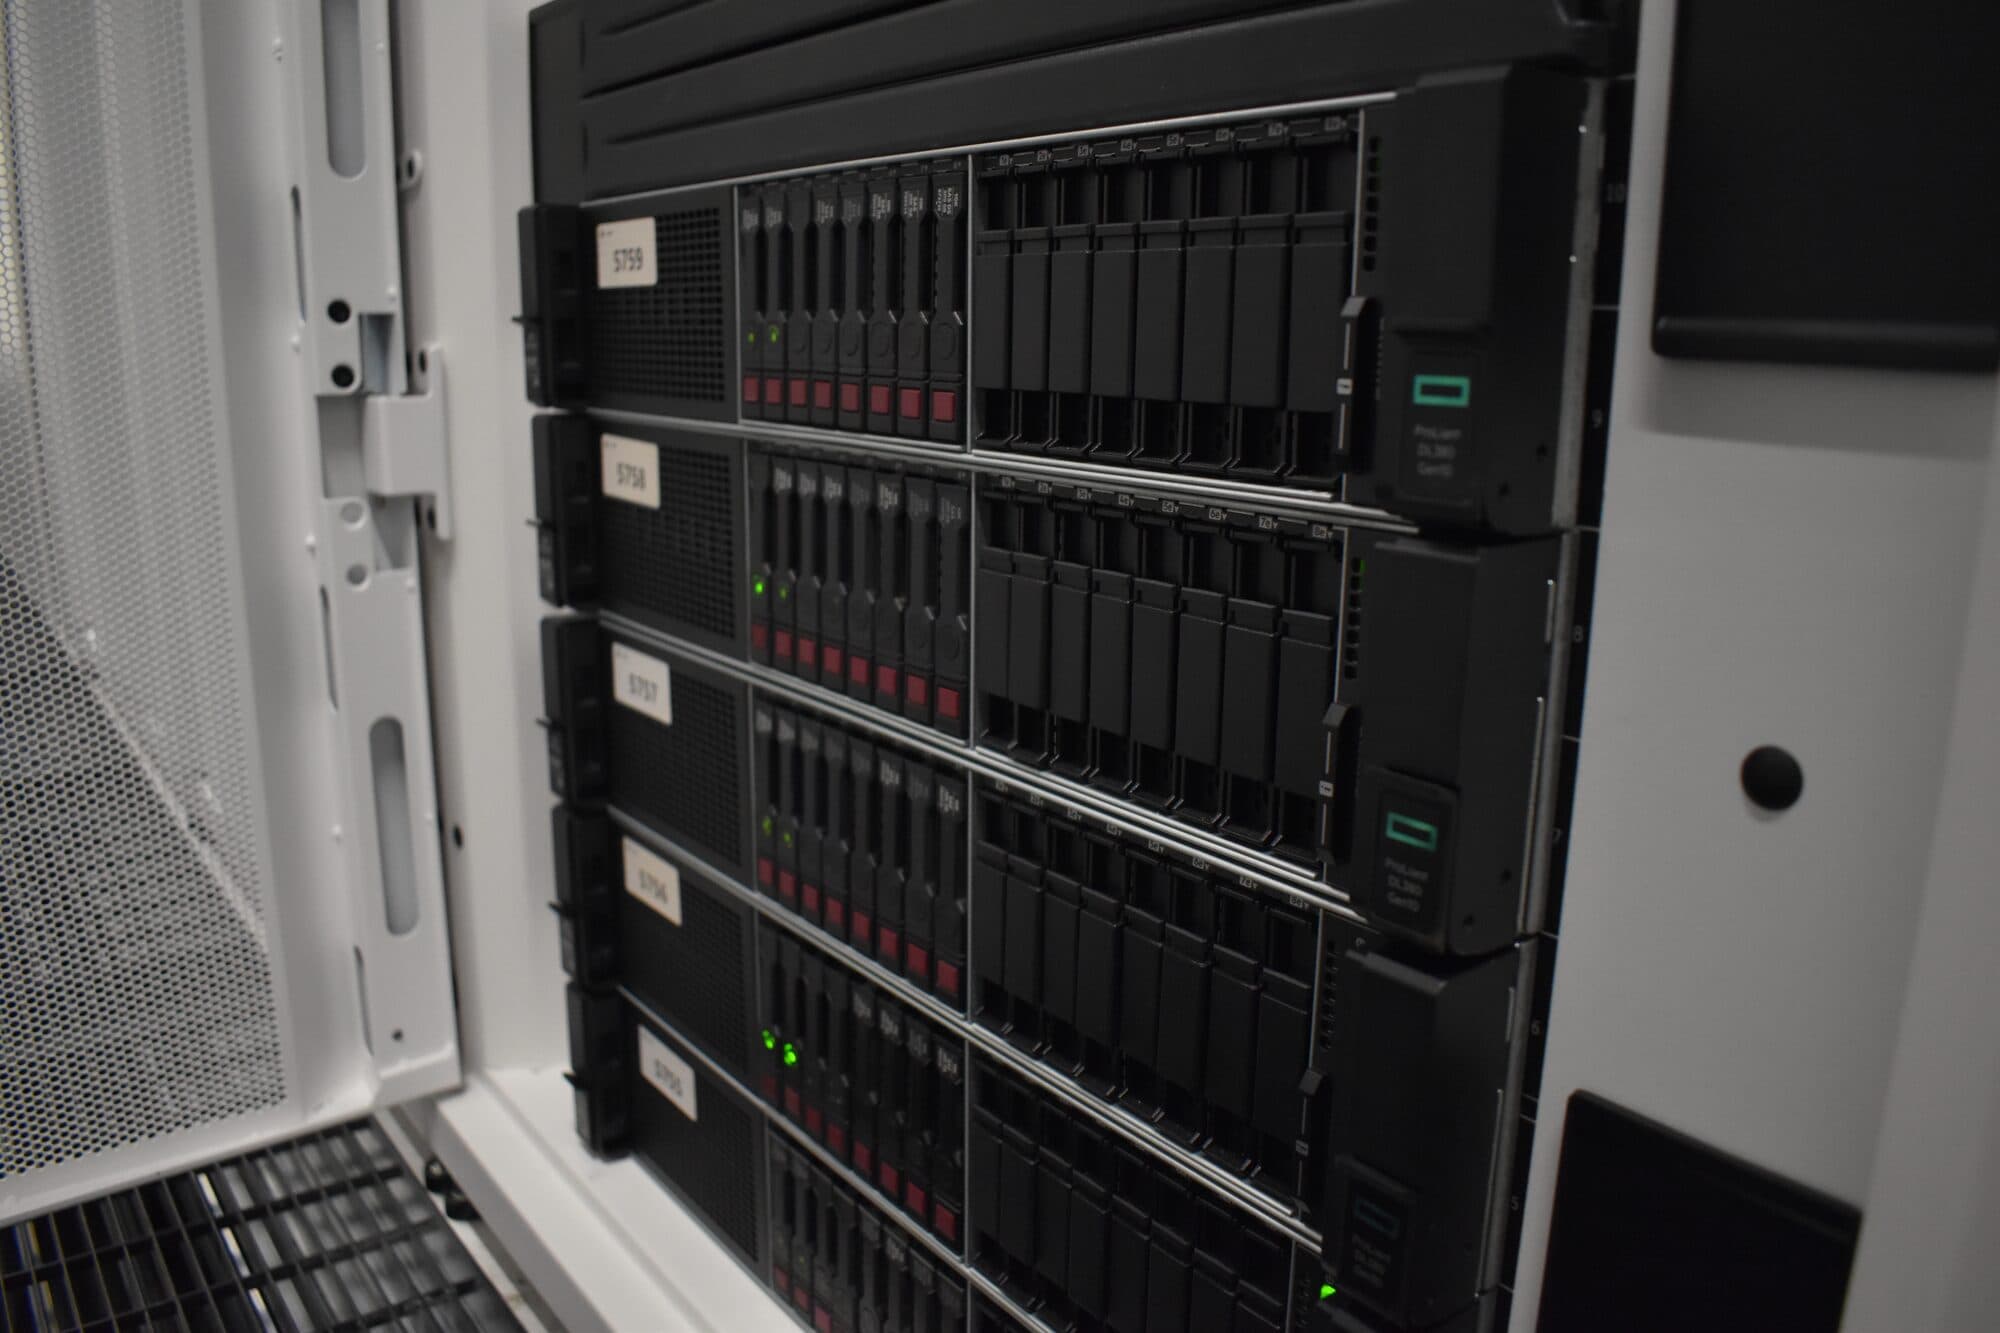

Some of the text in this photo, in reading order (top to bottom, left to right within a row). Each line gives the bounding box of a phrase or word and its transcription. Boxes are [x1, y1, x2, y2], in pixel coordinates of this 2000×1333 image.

[1573, 625, 1584, 643] 8
[1531, 1019, 1540, 1036] 6
[1510, 1197, 1520, 1211] 5
